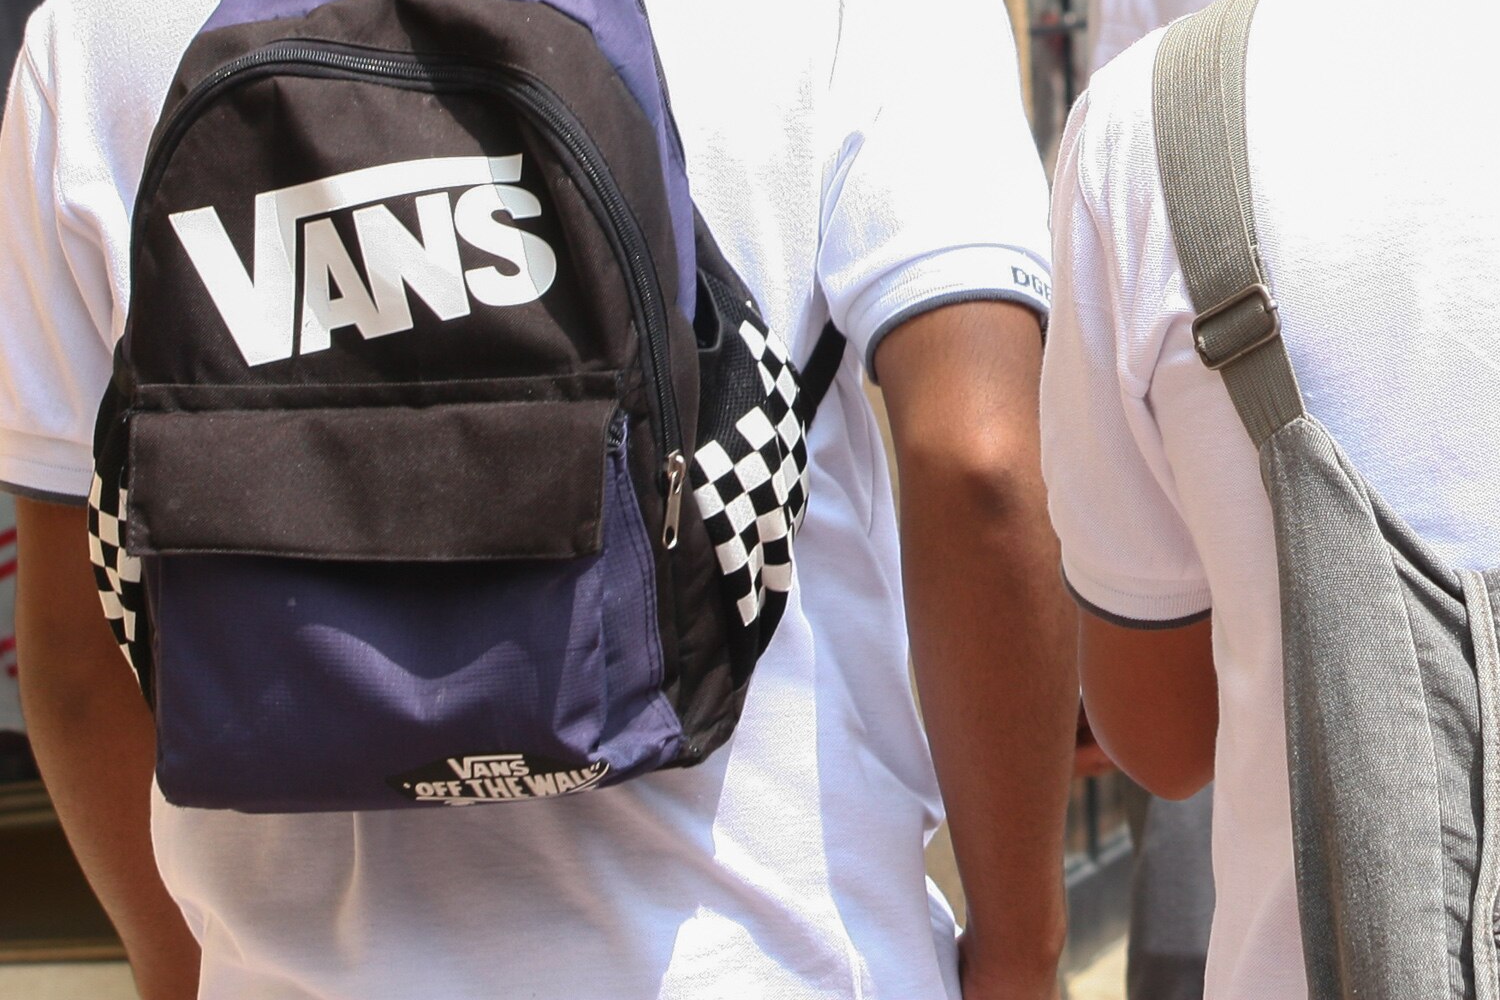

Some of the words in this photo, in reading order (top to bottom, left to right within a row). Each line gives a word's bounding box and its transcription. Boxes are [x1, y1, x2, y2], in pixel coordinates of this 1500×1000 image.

[168, 153, 557, 367] VANS
[447, 753, 530, 780] VANS
[465, 775, 531, 799] THE
